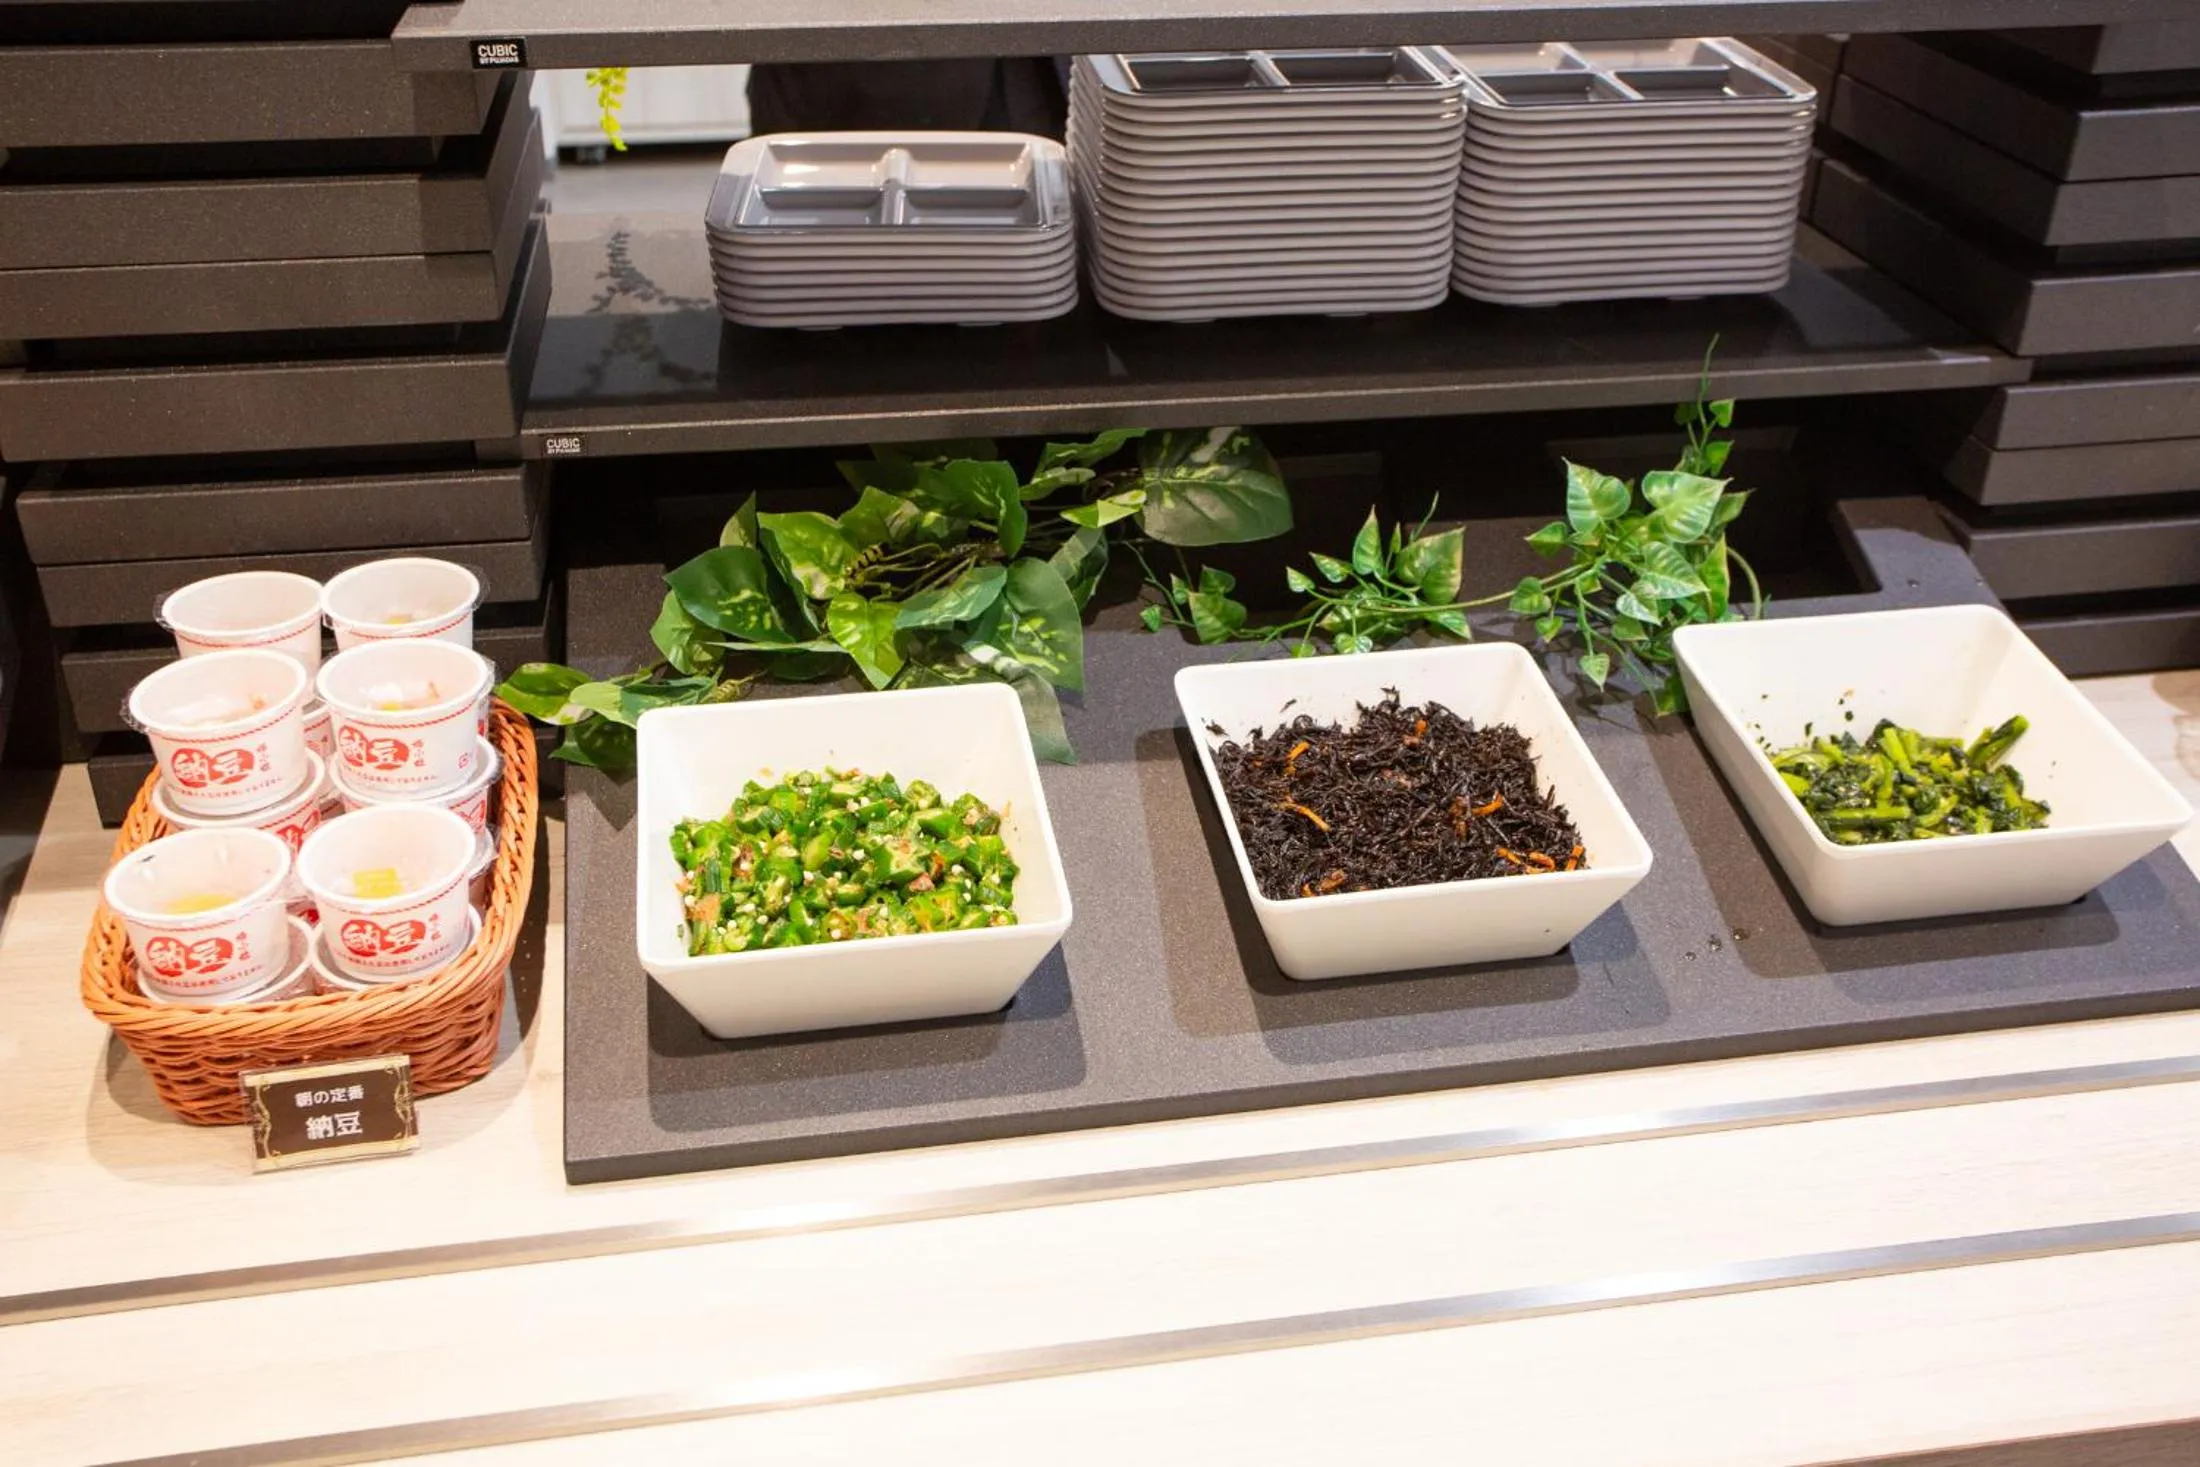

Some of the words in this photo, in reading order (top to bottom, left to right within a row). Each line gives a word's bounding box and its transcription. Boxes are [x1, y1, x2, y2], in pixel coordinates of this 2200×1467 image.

[478, 44, 518, 57] CUBIC
[546, 438, 580, 449] CUBIC
[340, 727, 409, 767] 納豆
[173, 749, 255, 784] 納豆
[342, 920, 426, 954] 納豆
[148, 938, 232, 974] 納豆
[295, 1084, 364, 1108] 朝の定番
[305, 1111, 363, 1139] 納豆
